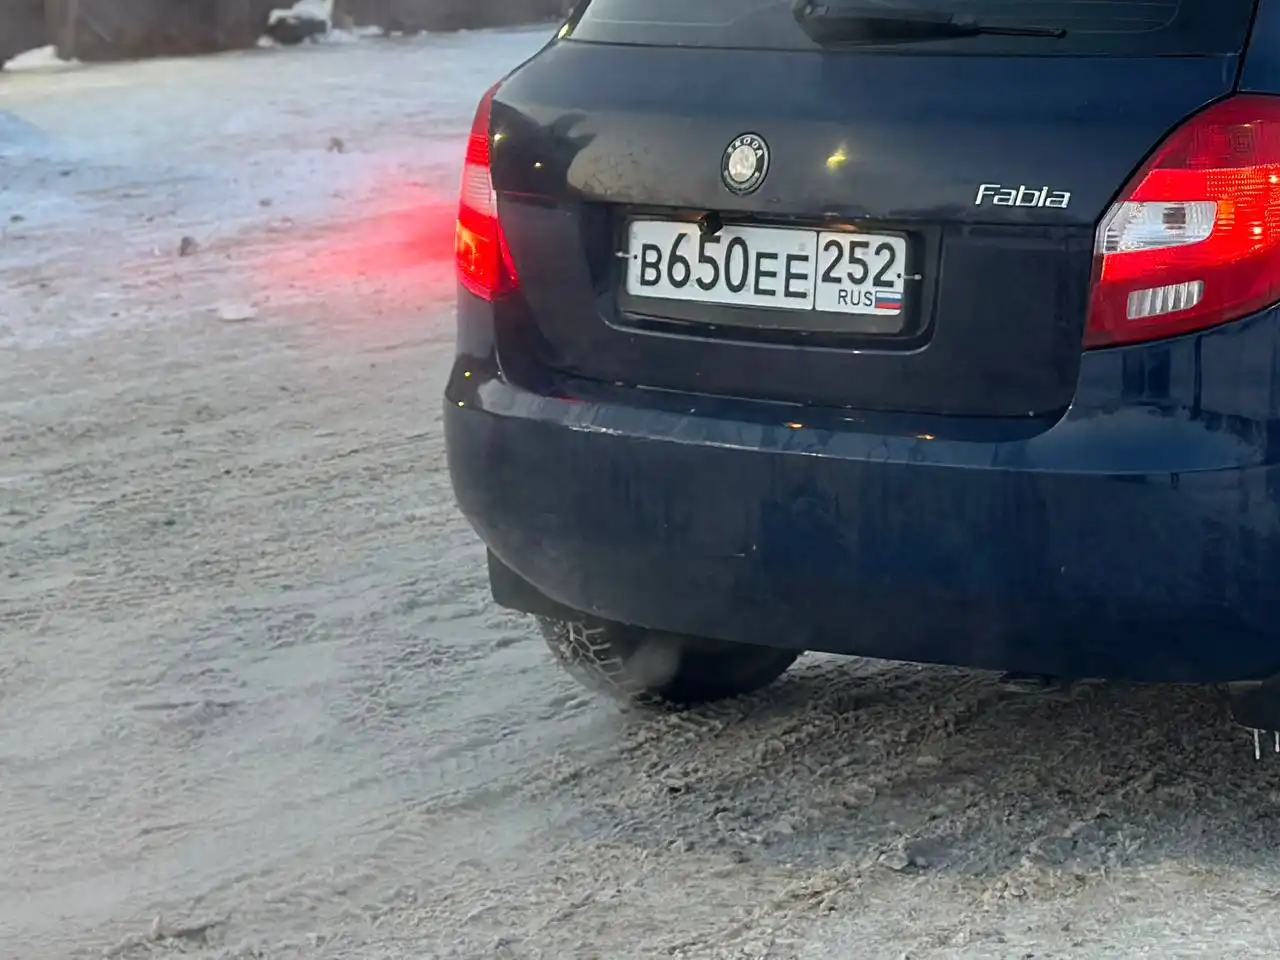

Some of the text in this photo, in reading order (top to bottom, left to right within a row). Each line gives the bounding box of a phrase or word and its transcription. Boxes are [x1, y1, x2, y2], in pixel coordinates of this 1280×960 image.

[975, 183, 1071, 208] Fabia
[821, 239, 897, 288] 252
[837, 289, 873, 307] RUS
